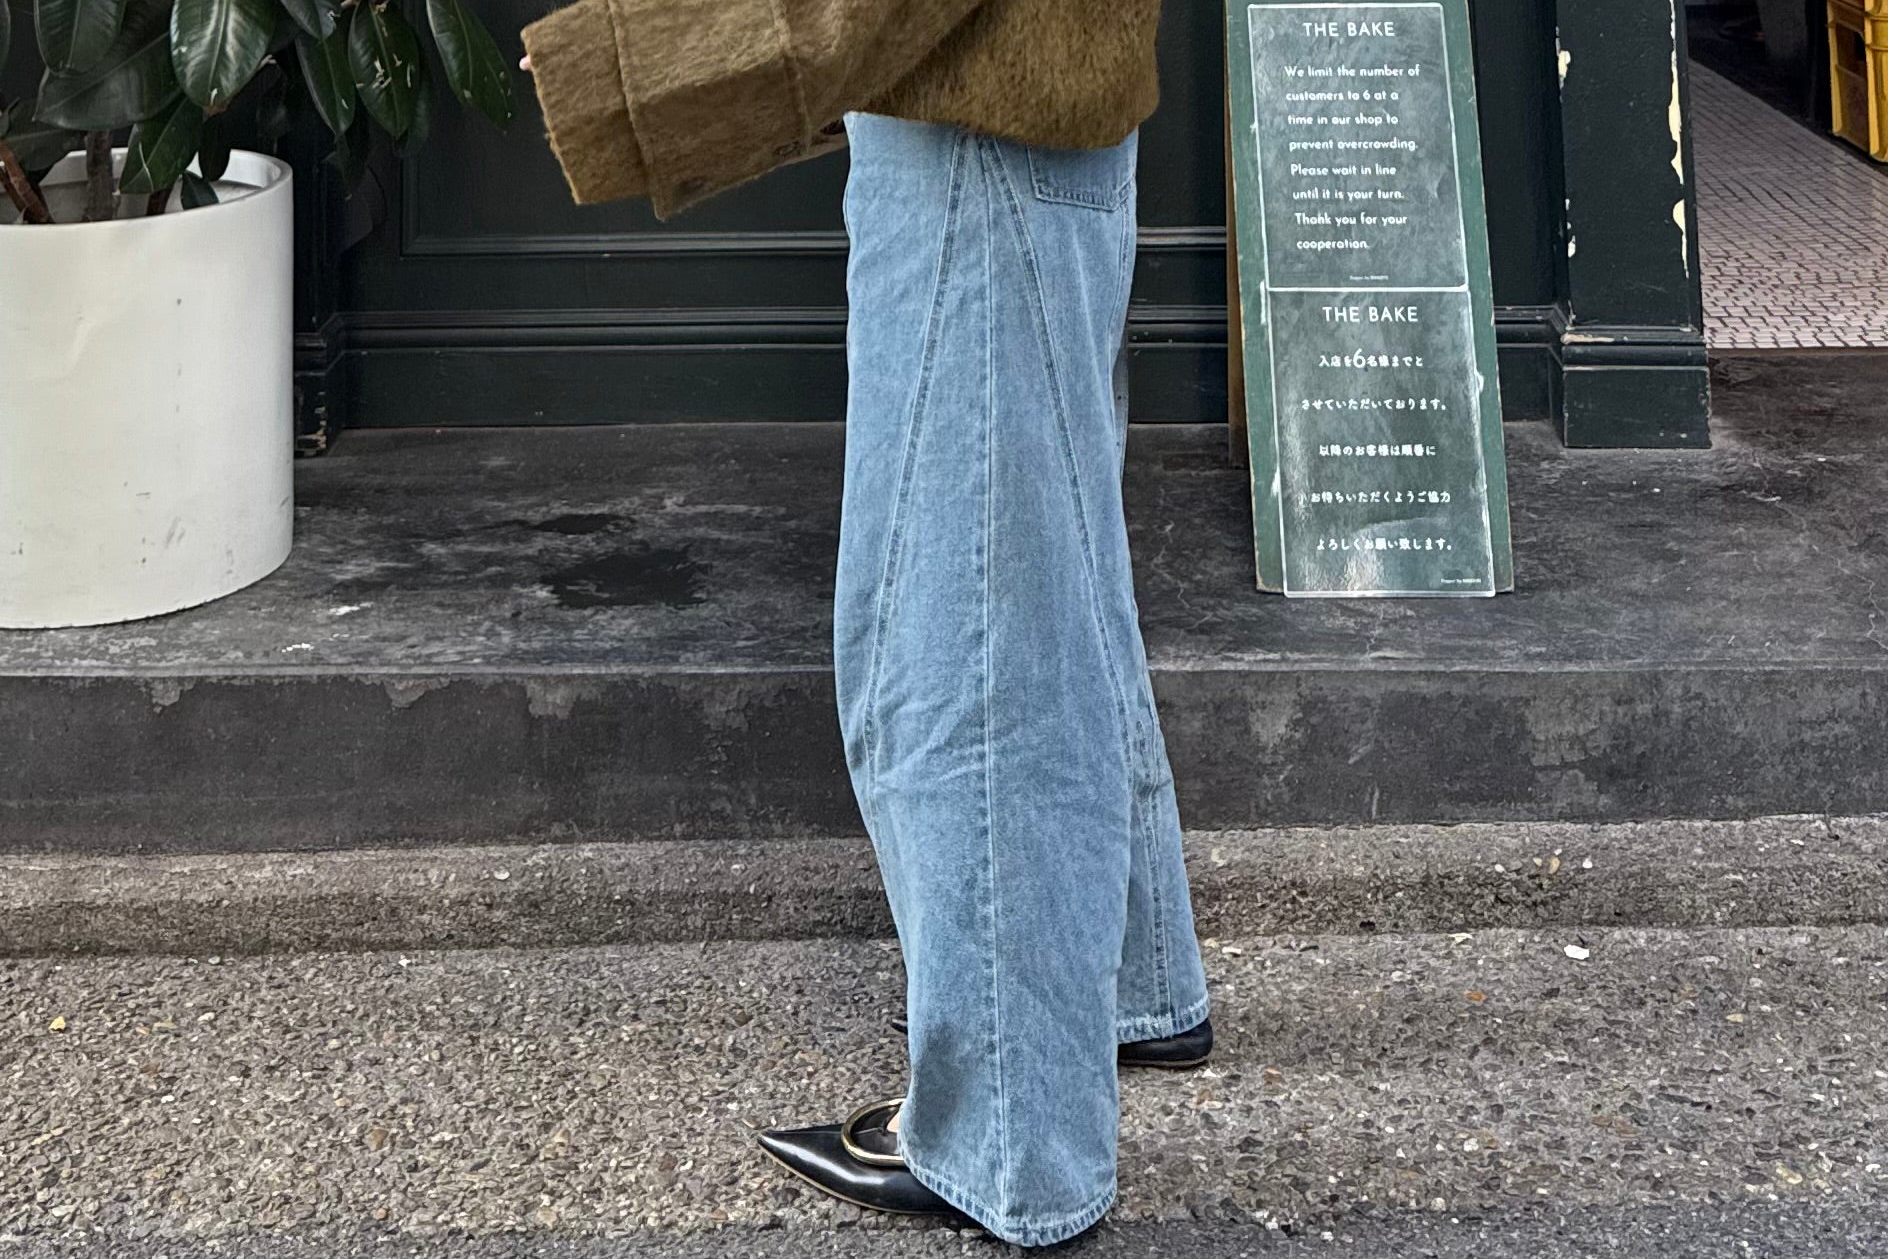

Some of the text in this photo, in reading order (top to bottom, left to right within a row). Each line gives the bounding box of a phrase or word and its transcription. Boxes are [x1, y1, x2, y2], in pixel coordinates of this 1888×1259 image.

[1302, 21, 1396, 37] THE BAKE
[1284, 64, 1421, 78] We limit the number of
[1285, 90, 1399, 102] customers to 6 at a
[1287, 114, 1399, 127] time in our shop to
[1288, 138, 1419, 152] prevent overcrowding.
[1290, 163, 1397, 176] Please wait in line
[1292, 187, 1405, 202] until it is your turn.
[1294, 212, 1408, 227] Thank you for your
[1321, 306, 1419, 323] THE BAKE
[1301, 398, 1447, 410] させていただいております。
